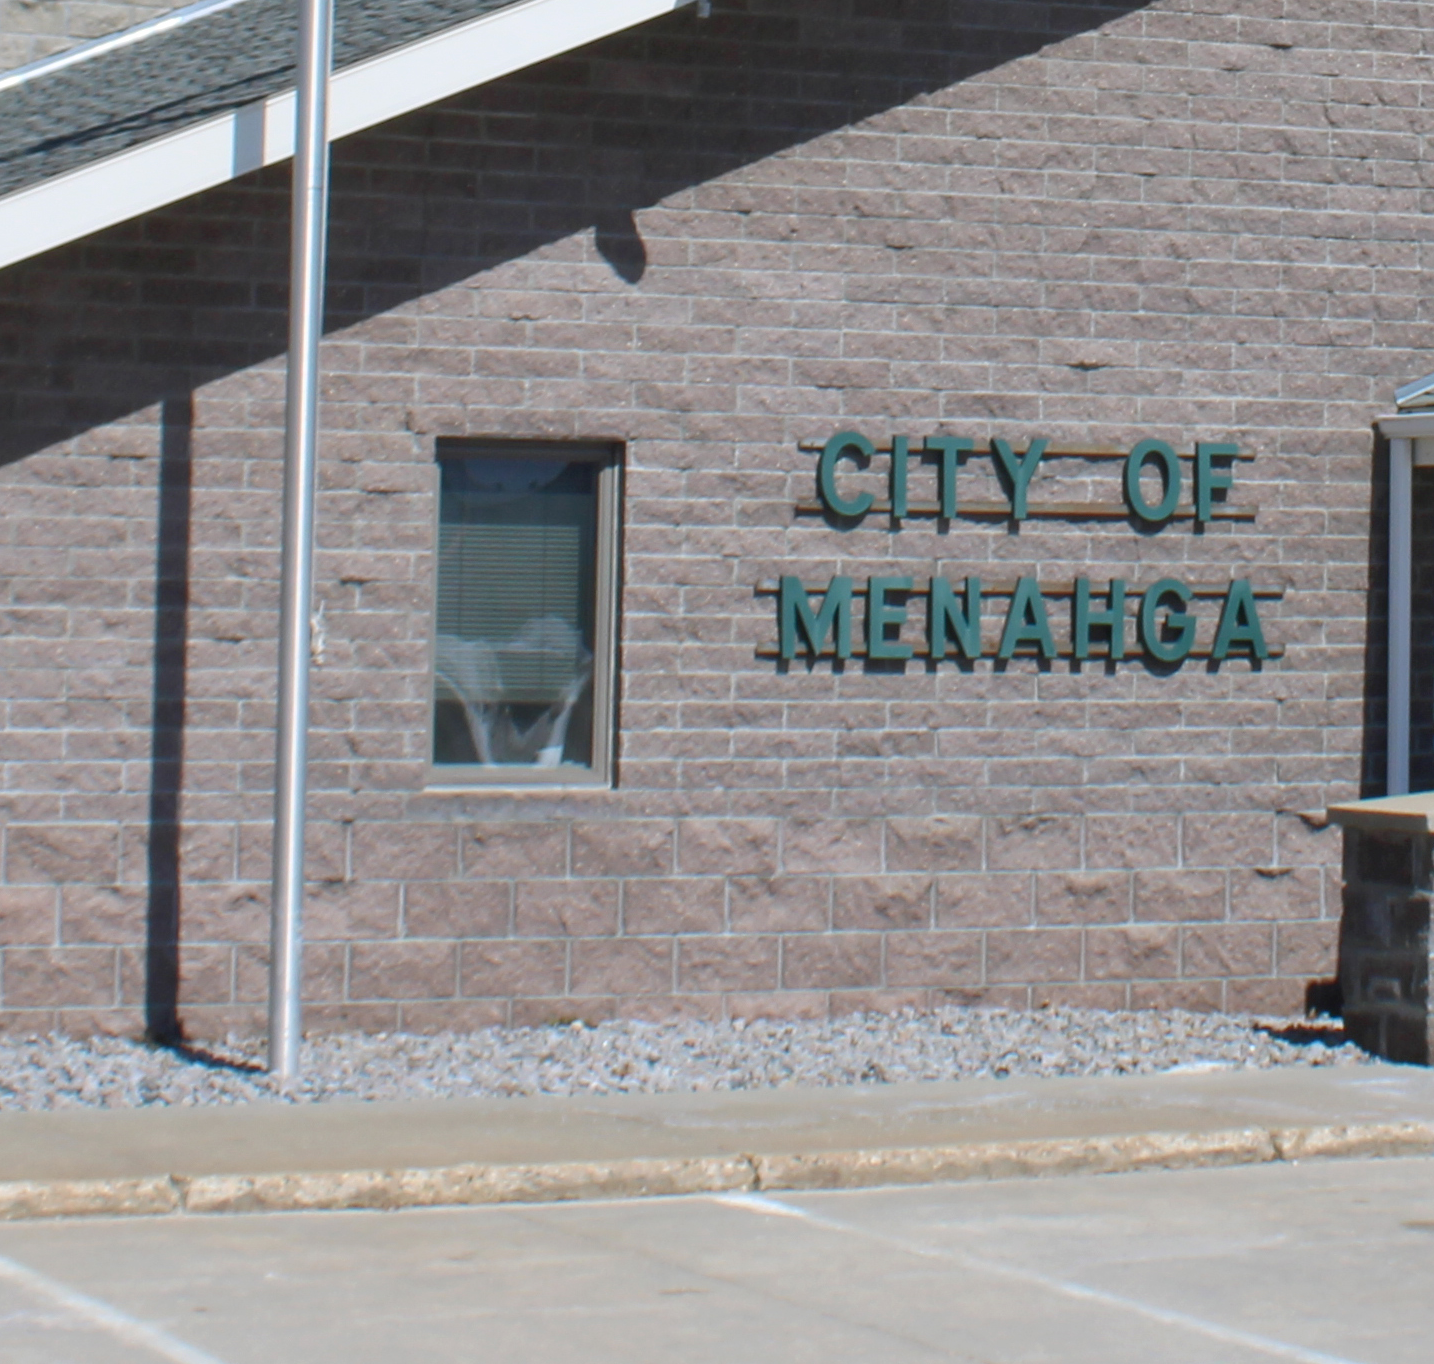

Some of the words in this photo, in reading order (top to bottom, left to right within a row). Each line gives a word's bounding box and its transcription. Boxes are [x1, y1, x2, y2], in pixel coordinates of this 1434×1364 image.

[819, 431, 1047, 520] CITY
[1126, 439, 1239, 523] OF
[778, 575, 1268, 662] MENAHGA
